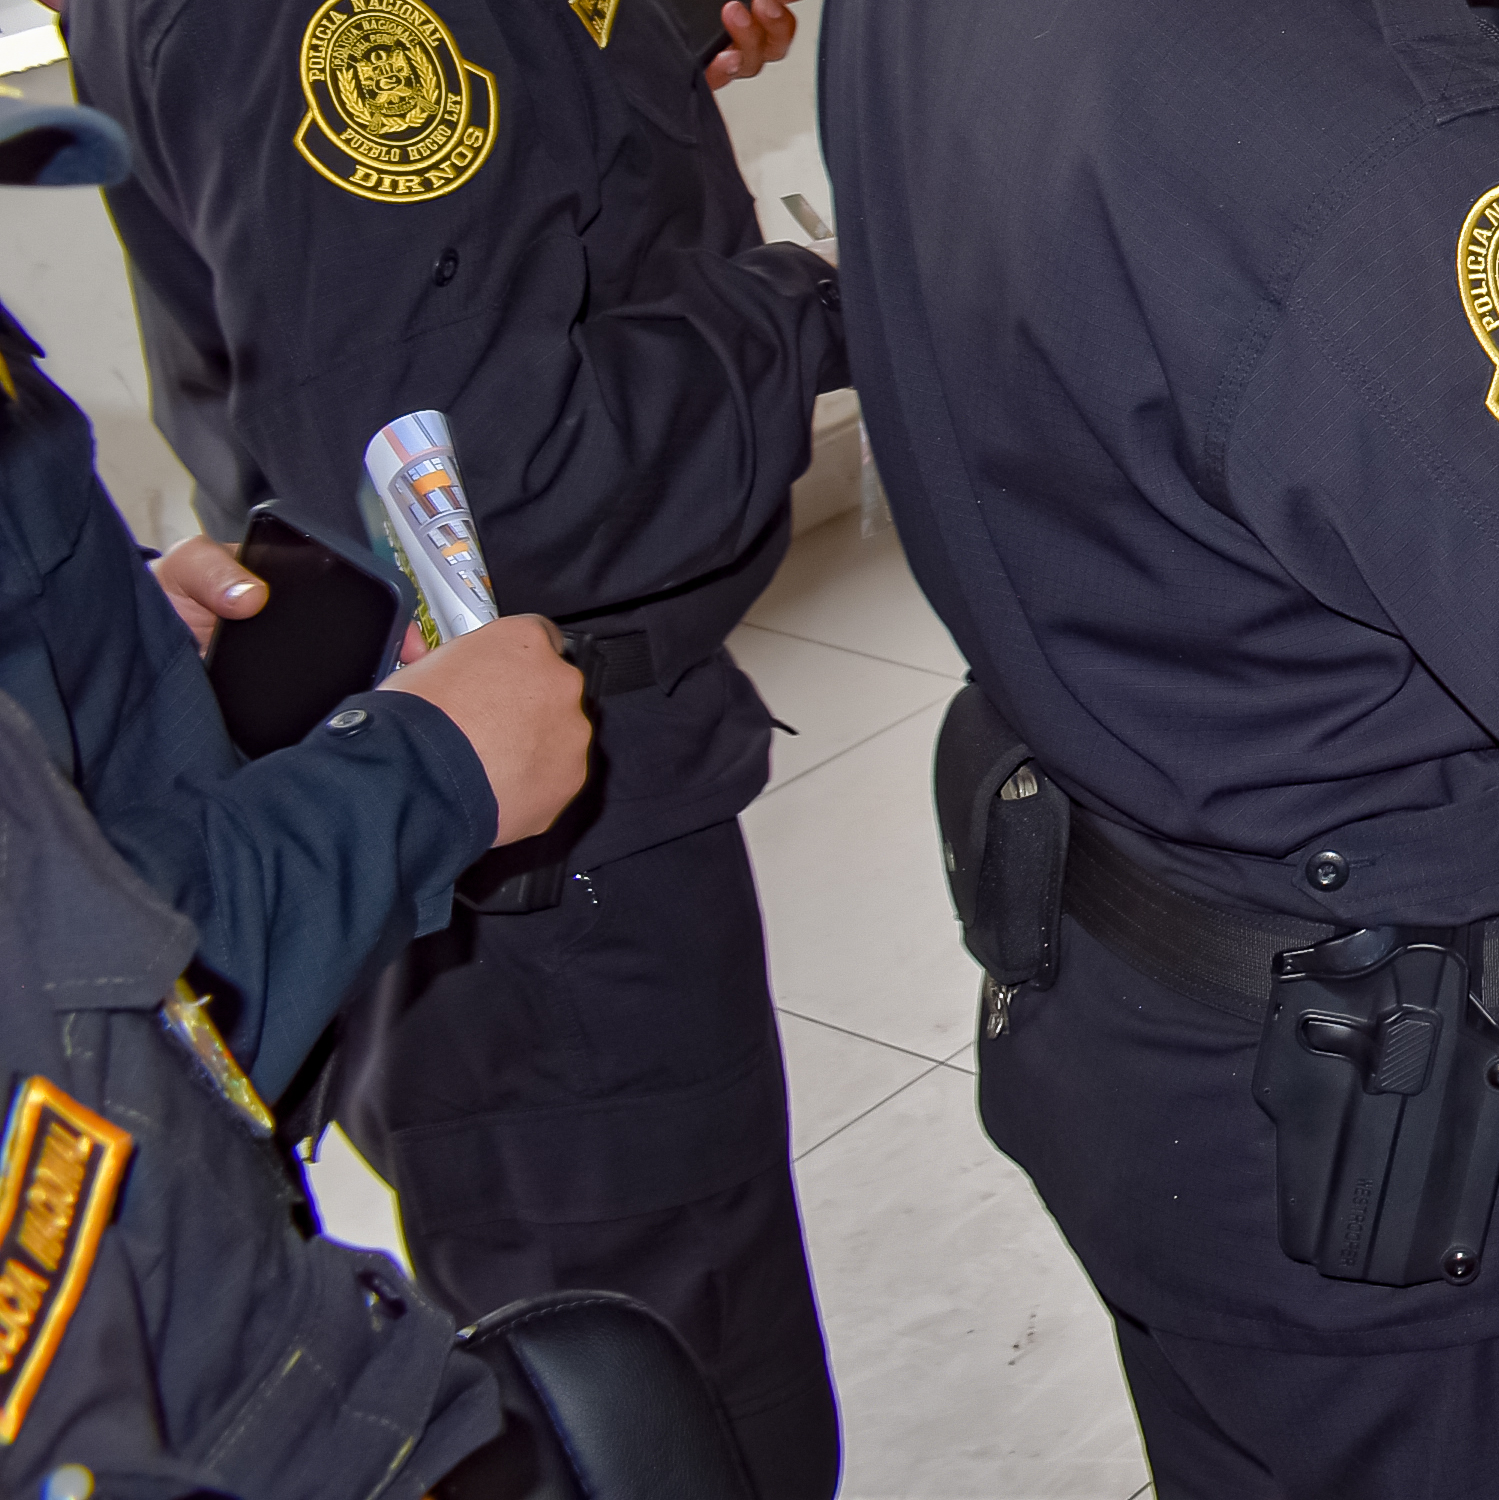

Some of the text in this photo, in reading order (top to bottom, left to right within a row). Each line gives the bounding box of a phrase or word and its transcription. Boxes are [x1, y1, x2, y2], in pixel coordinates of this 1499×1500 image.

[309, 8, 348, 83] POLICIA
[339, 127, 400, 162] PUEBLO
[408, 124, 452, 161] HECHO
[349, 125, 486, 194] DIRNOS
